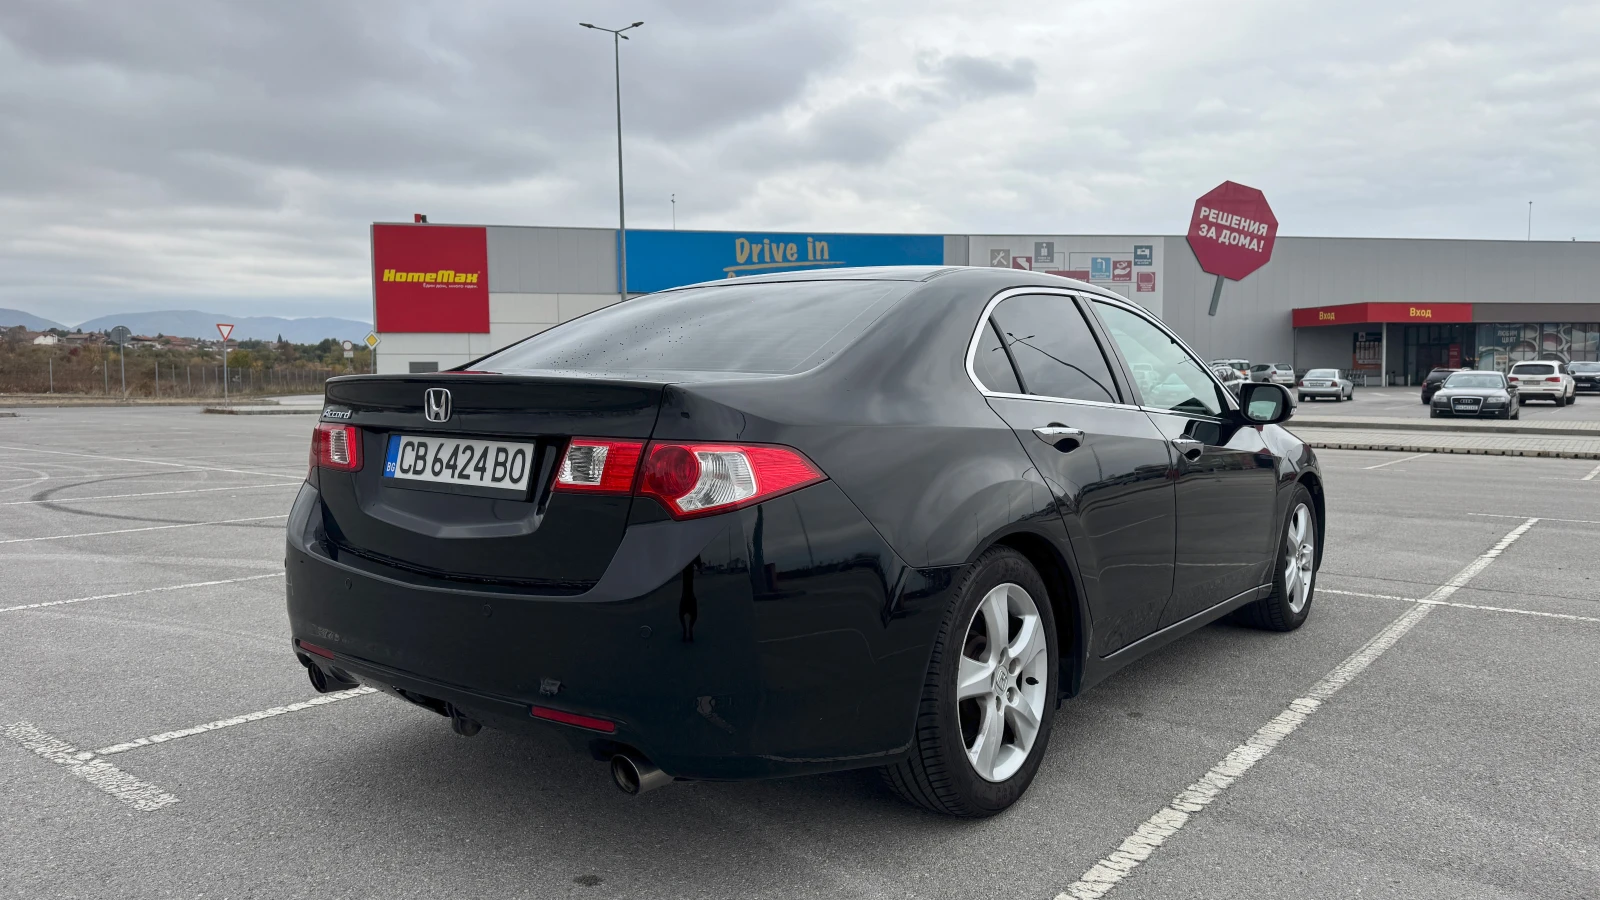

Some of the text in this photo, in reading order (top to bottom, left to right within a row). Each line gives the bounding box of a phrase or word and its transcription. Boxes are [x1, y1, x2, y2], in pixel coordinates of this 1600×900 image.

[1199, 206, 1269, 237] РЕШЕНИЯ
[1198, 223, 1265, 253] ЗА ДОМА!
[735, 236, 829, 264] Drive in
[382, 269, 479, 283] HomeMax
[1319, 311, 1336, 321] Вход
[1409, 307, 1432, 318] Вход
[323, 409, 352, 419] Accord
[386, 461, 396, 472] BG
[431, 443, 490, 481] 6424
